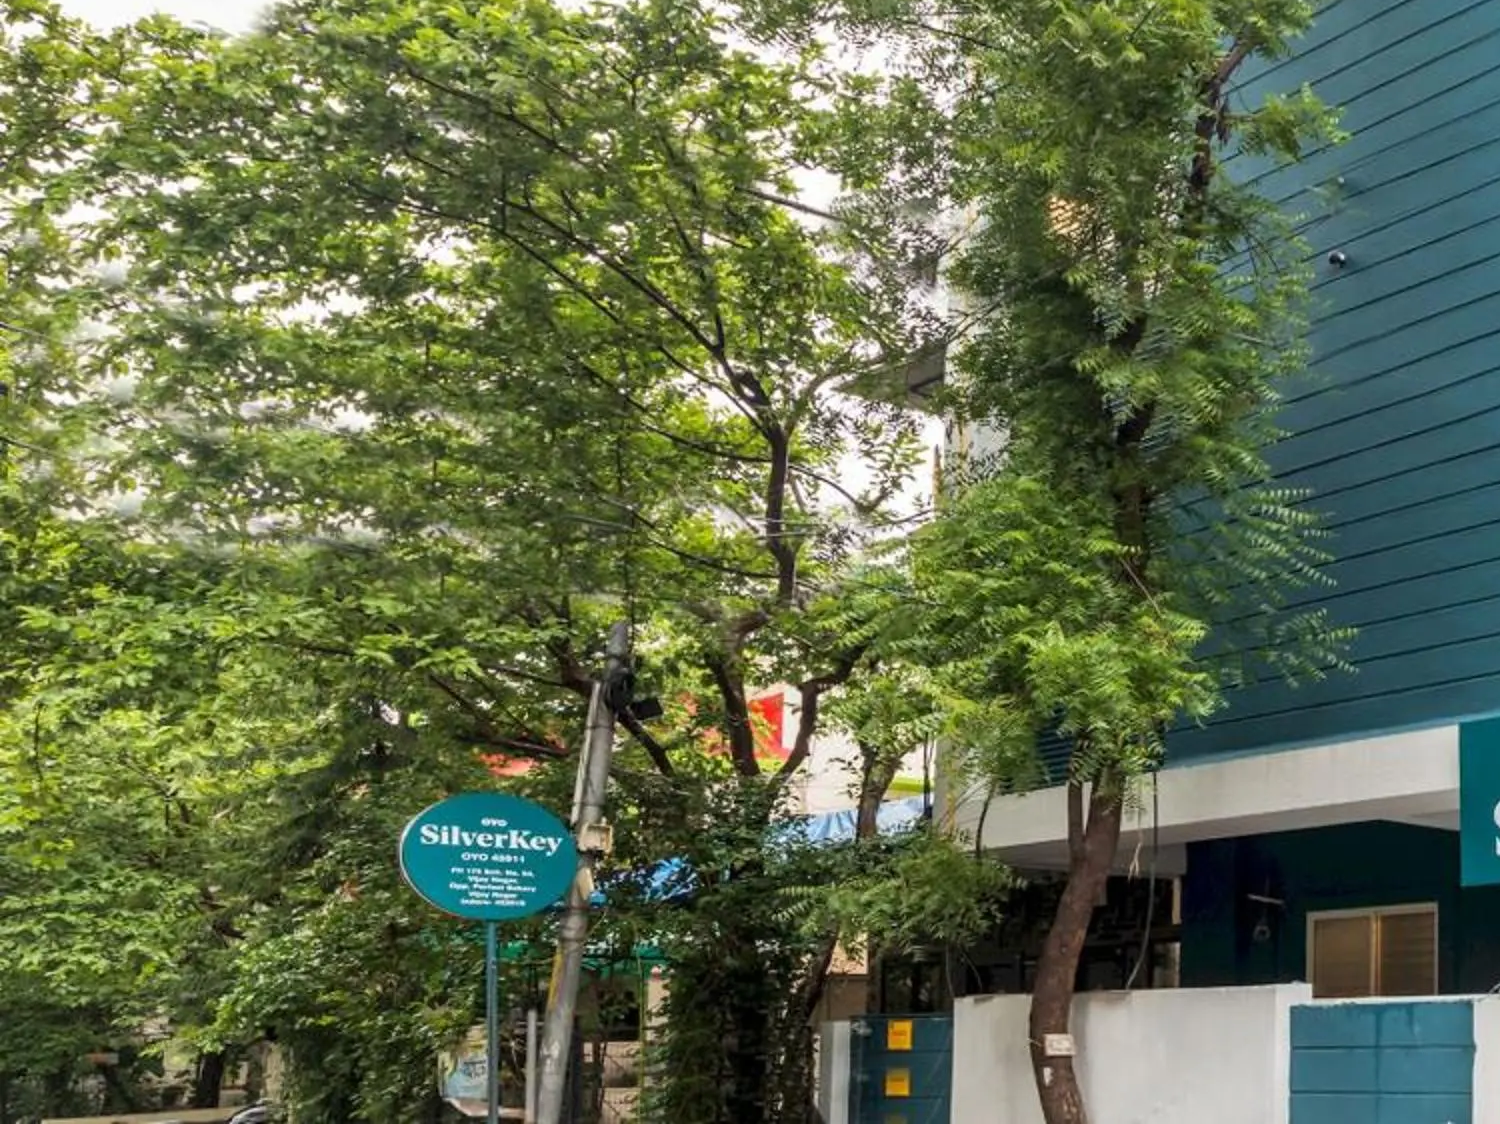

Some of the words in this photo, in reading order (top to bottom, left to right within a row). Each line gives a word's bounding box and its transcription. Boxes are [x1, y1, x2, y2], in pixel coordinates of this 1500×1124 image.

[481, 817, 508, 827] OYO
[420, 823, 563, 857] SilverKey
[461, 852, 489, 861] OYO
